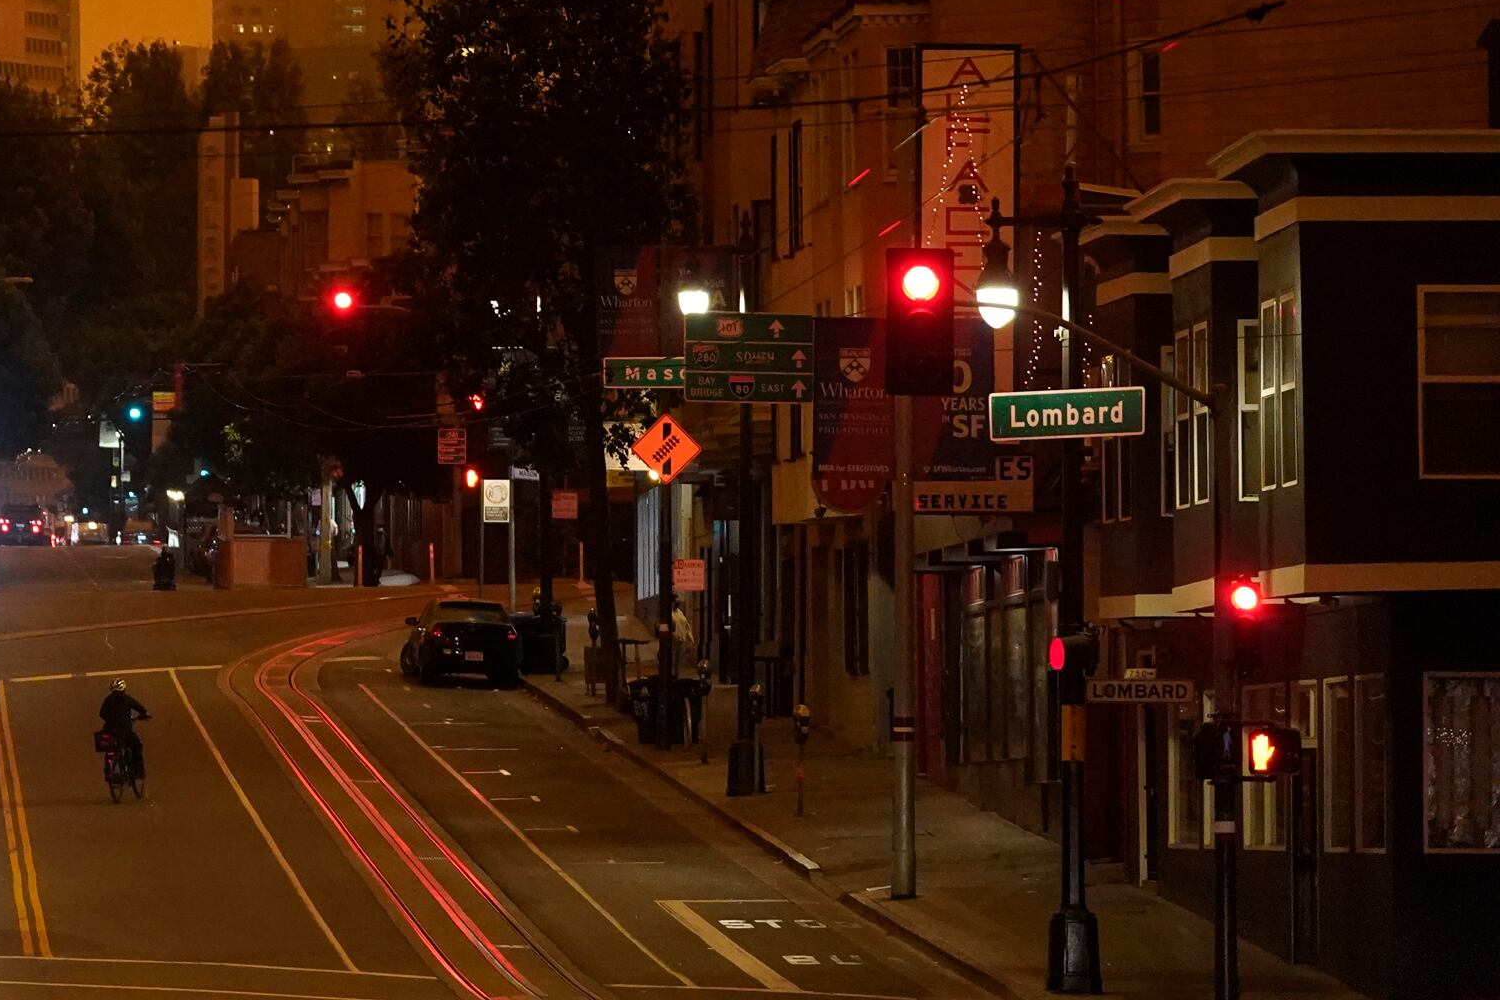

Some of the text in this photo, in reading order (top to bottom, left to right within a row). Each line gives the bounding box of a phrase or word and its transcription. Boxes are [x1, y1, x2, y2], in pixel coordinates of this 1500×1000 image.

[600, 295, 654, 309] Wharton
[696, 352, 716, 363] 280
[698, 376, 716, 386] BAY
[690, 387, 724, 398] BRIDGE
[735, 384, 750, 394] 80
[759, 383, 785, 393] EAST
[941, 397, 987, 412] YEARS
[1009, 400, 1123, 429] Lombard
[952, 414, 987, 440] SF
[818, 463, 835, 473] MBA
[847, 463, 890, 473] EXECUTIVES
[917, 494, 1008, 510] SERVICE
[1092, 683, 1189, 700] LOMBARD
